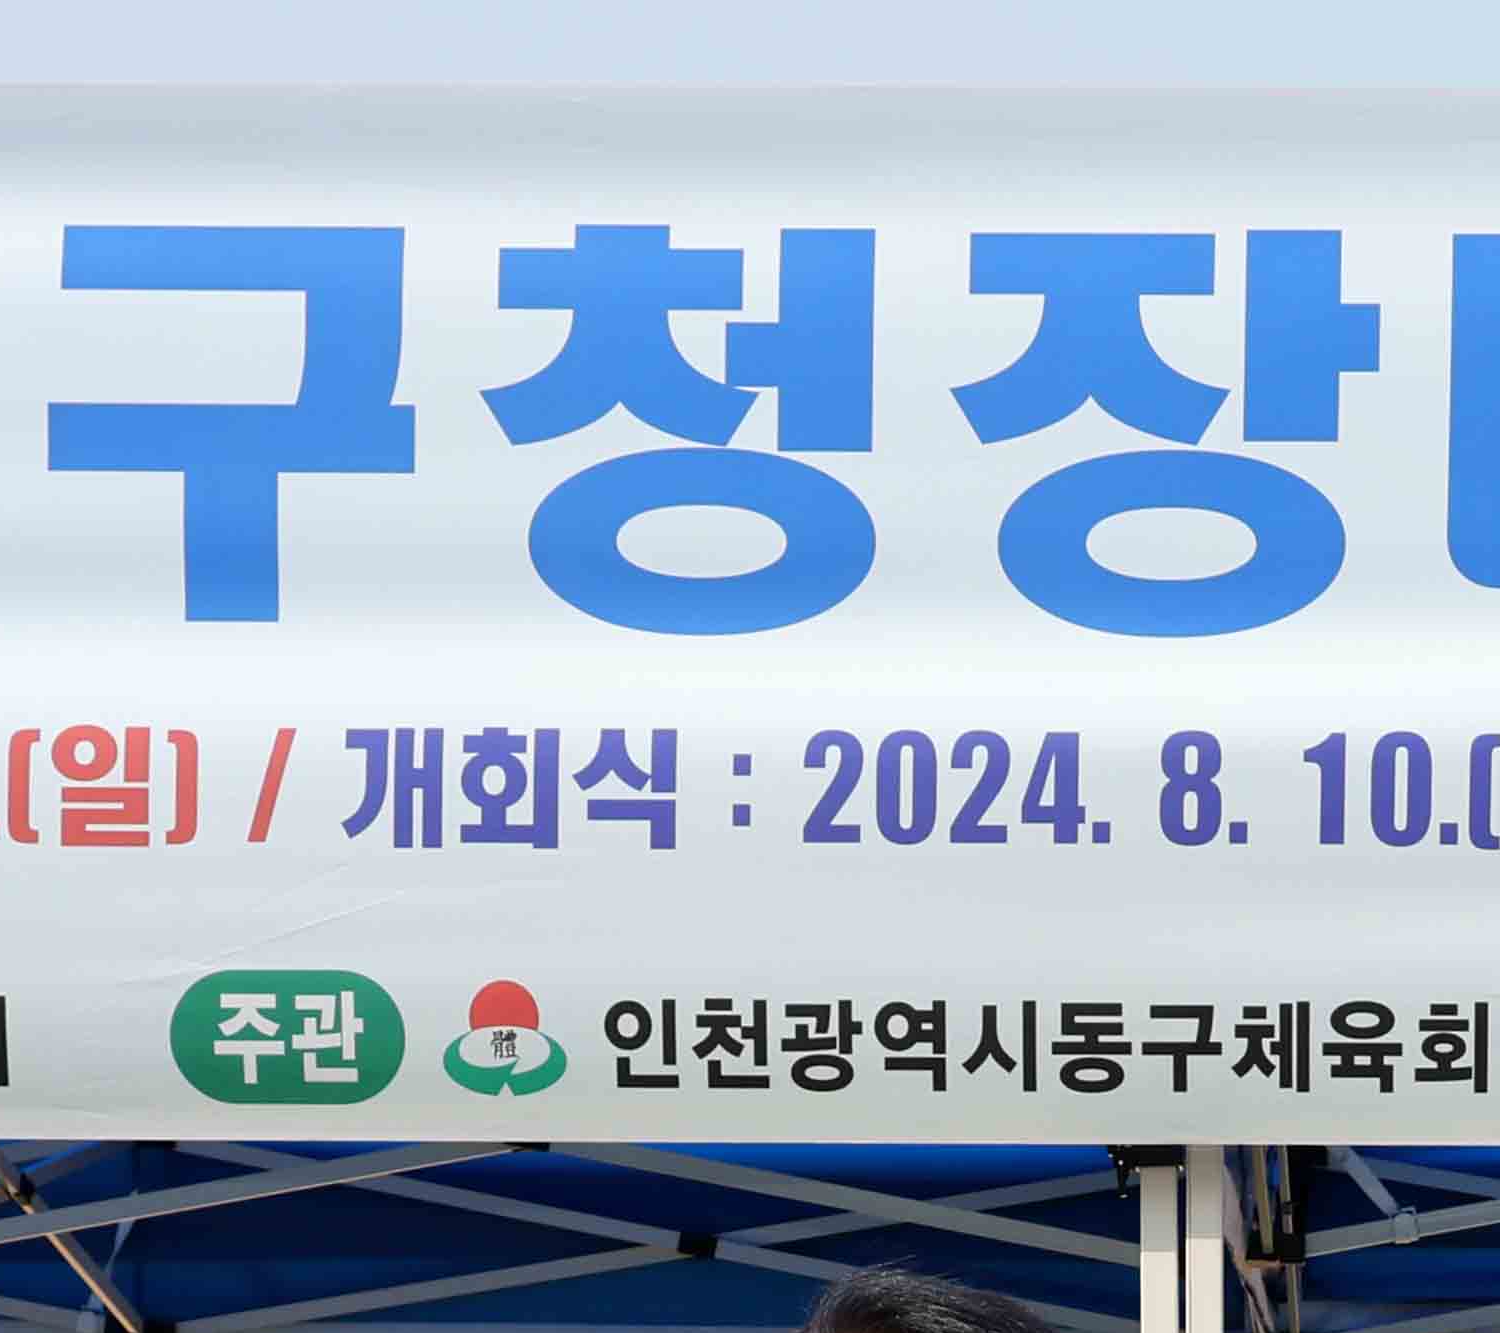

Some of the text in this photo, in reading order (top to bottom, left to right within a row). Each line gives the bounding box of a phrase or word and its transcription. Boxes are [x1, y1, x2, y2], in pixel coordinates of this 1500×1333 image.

[248, 726, 295, 843] /
[341, 727, 679, 850] 개회식
[802, 730, 1110, 845] 2024.
[1159, 730, 1247, 845] 8.
[210, 992, 366, 1084] 주관
[601, 996, 1492, 1097] 인천광역시동구체육회
